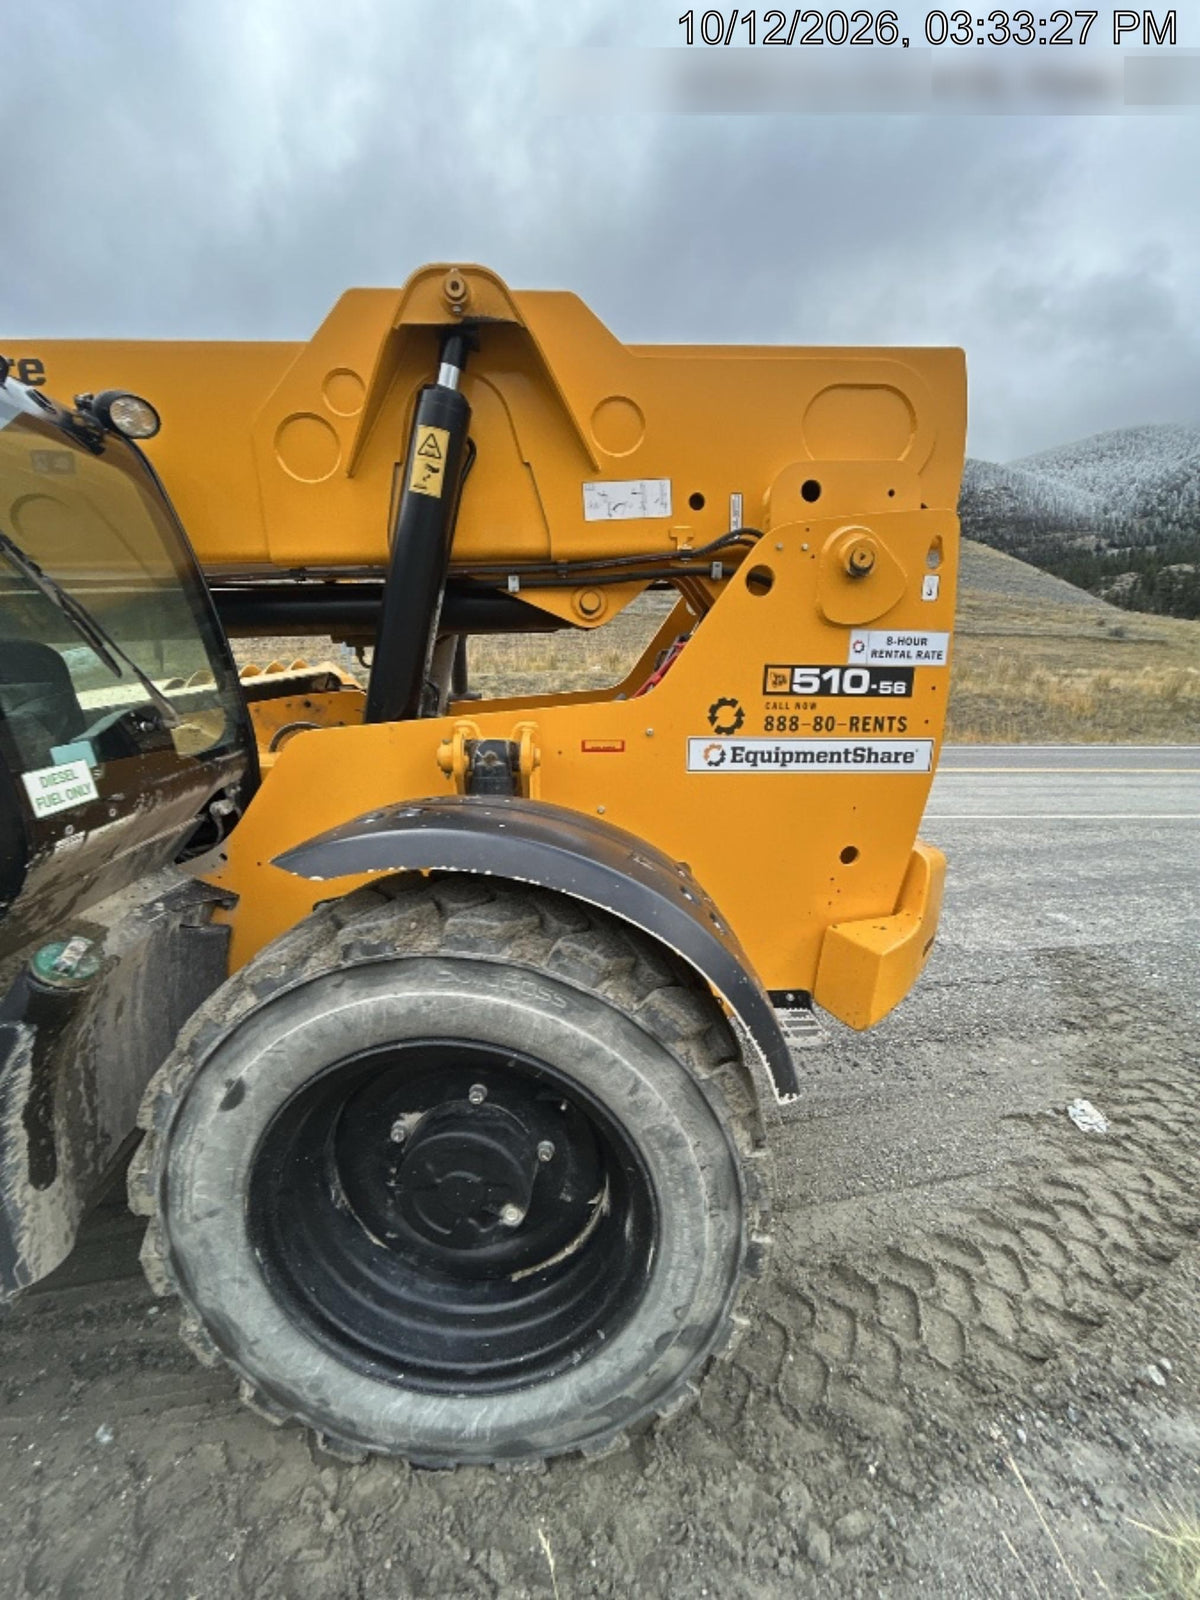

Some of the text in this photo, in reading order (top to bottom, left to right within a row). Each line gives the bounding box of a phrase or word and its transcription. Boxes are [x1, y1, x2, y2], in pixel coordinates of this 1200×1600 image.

[886, 636, 928, 646] 8-HOUR
[870, 649, 943, 660] RENTAL RATE
[764, 702, 817, 710] CALL NOW
[763, 715, 908, 733] 888-80-RENTS
[730, 746, 915, 767] EquipmentShare
[35, 783, 91, 811] FUEL ONLY
